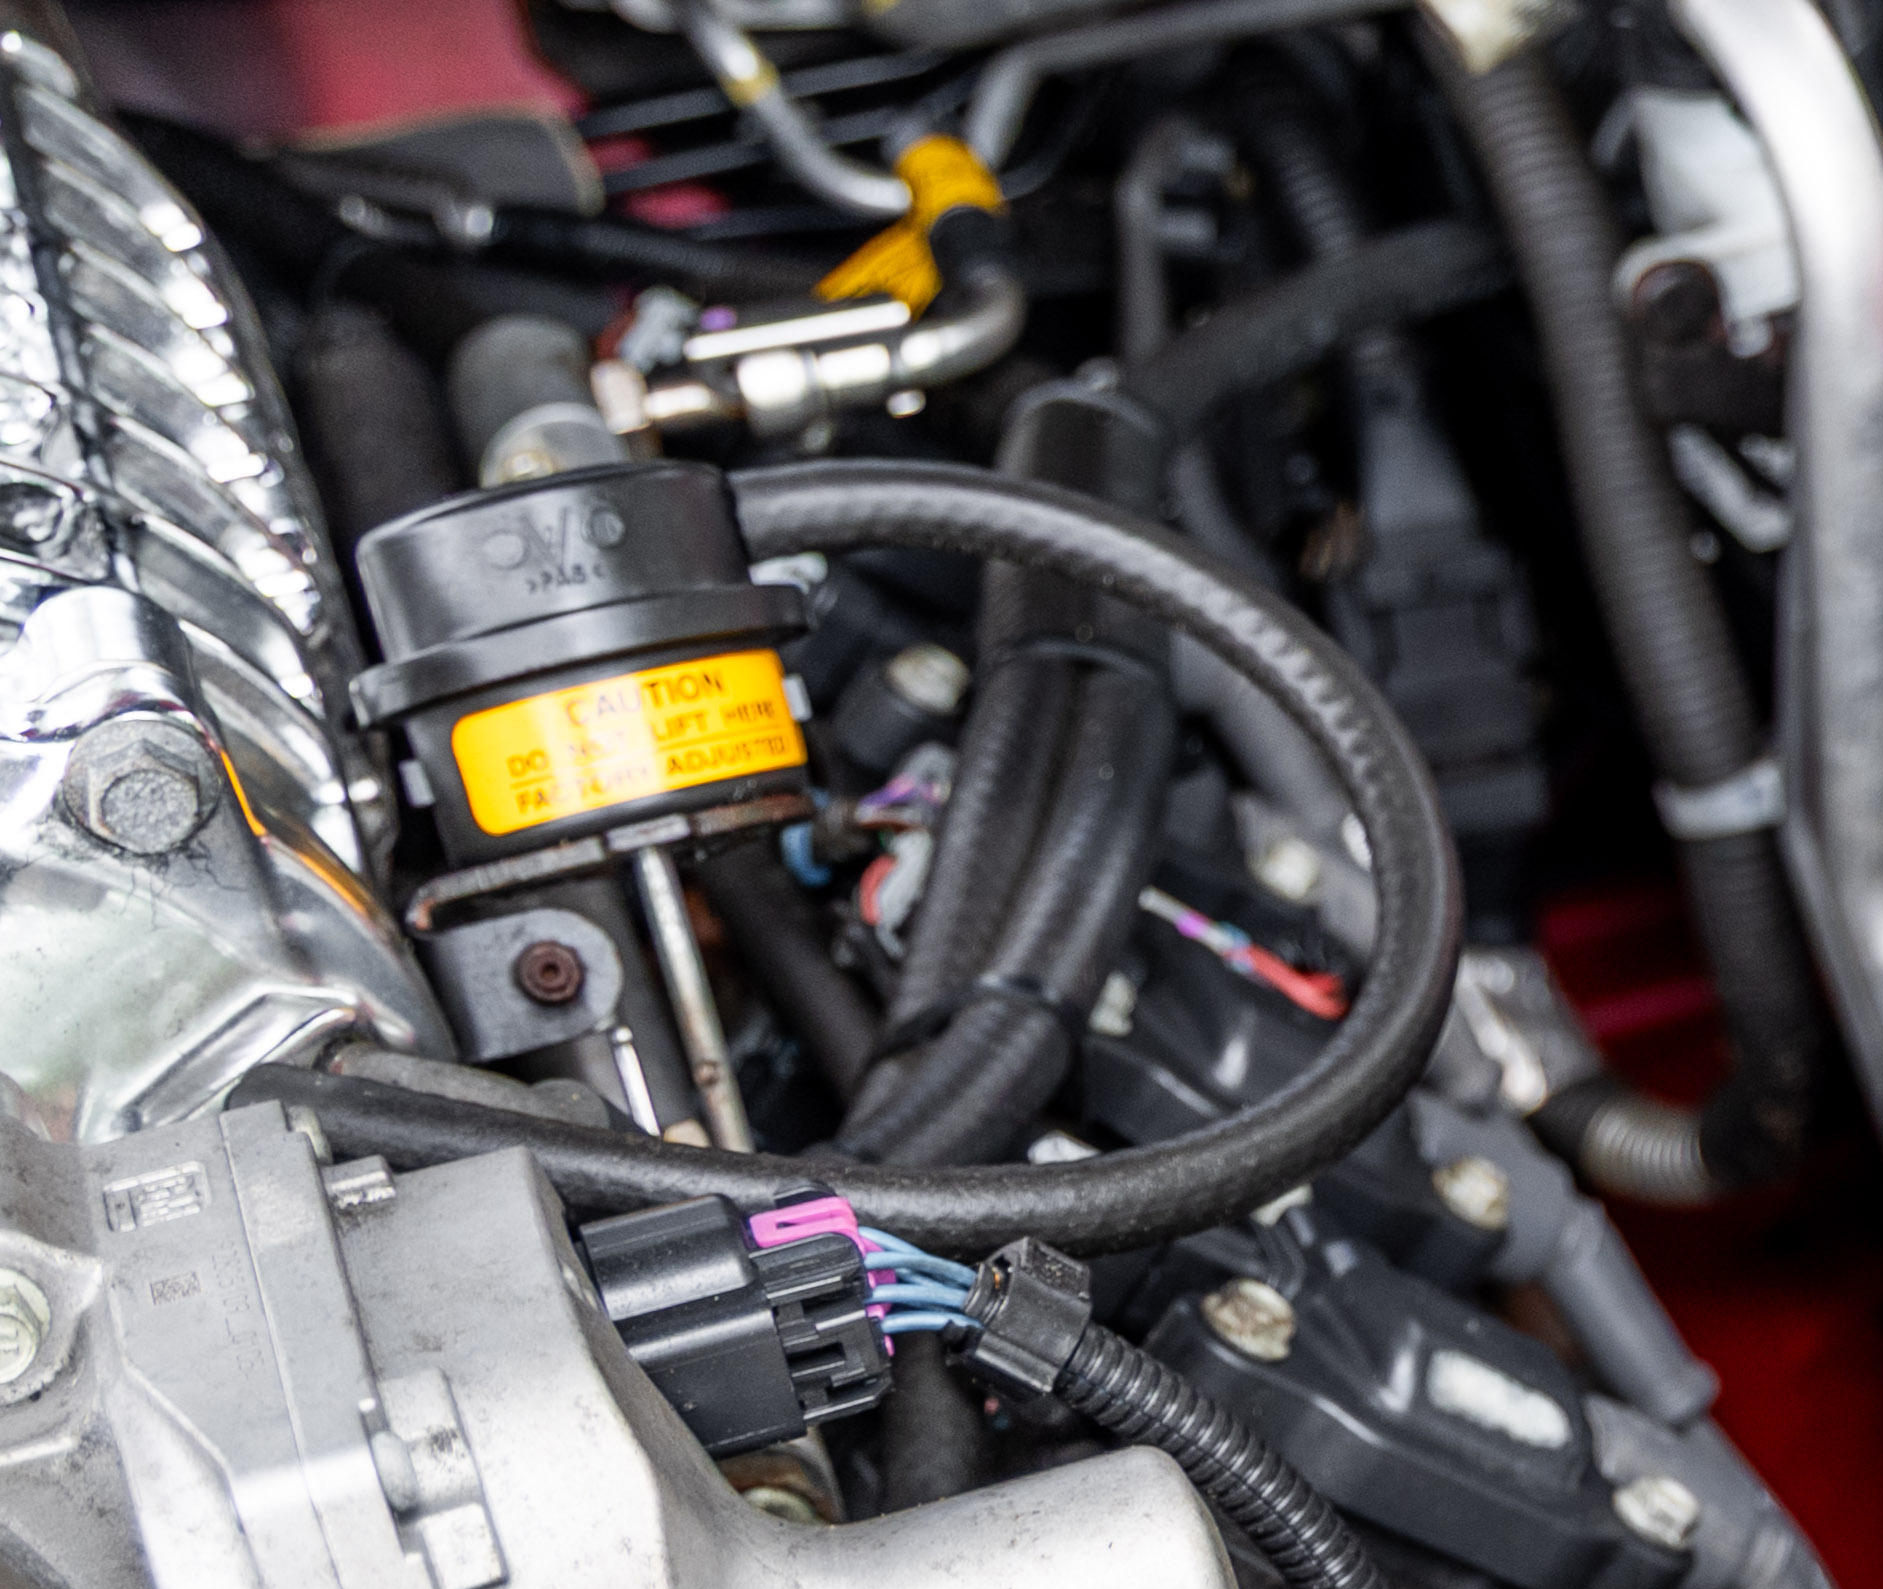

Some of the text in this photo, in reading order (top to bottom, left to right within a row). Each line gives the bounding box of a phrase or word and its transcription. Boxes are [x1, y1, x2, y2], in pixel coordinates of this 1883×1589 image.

[568, 673, 723, 726] CAUTION
[507, 749, 549, 779] DO
[650, 713, 709, 743] LIFT
